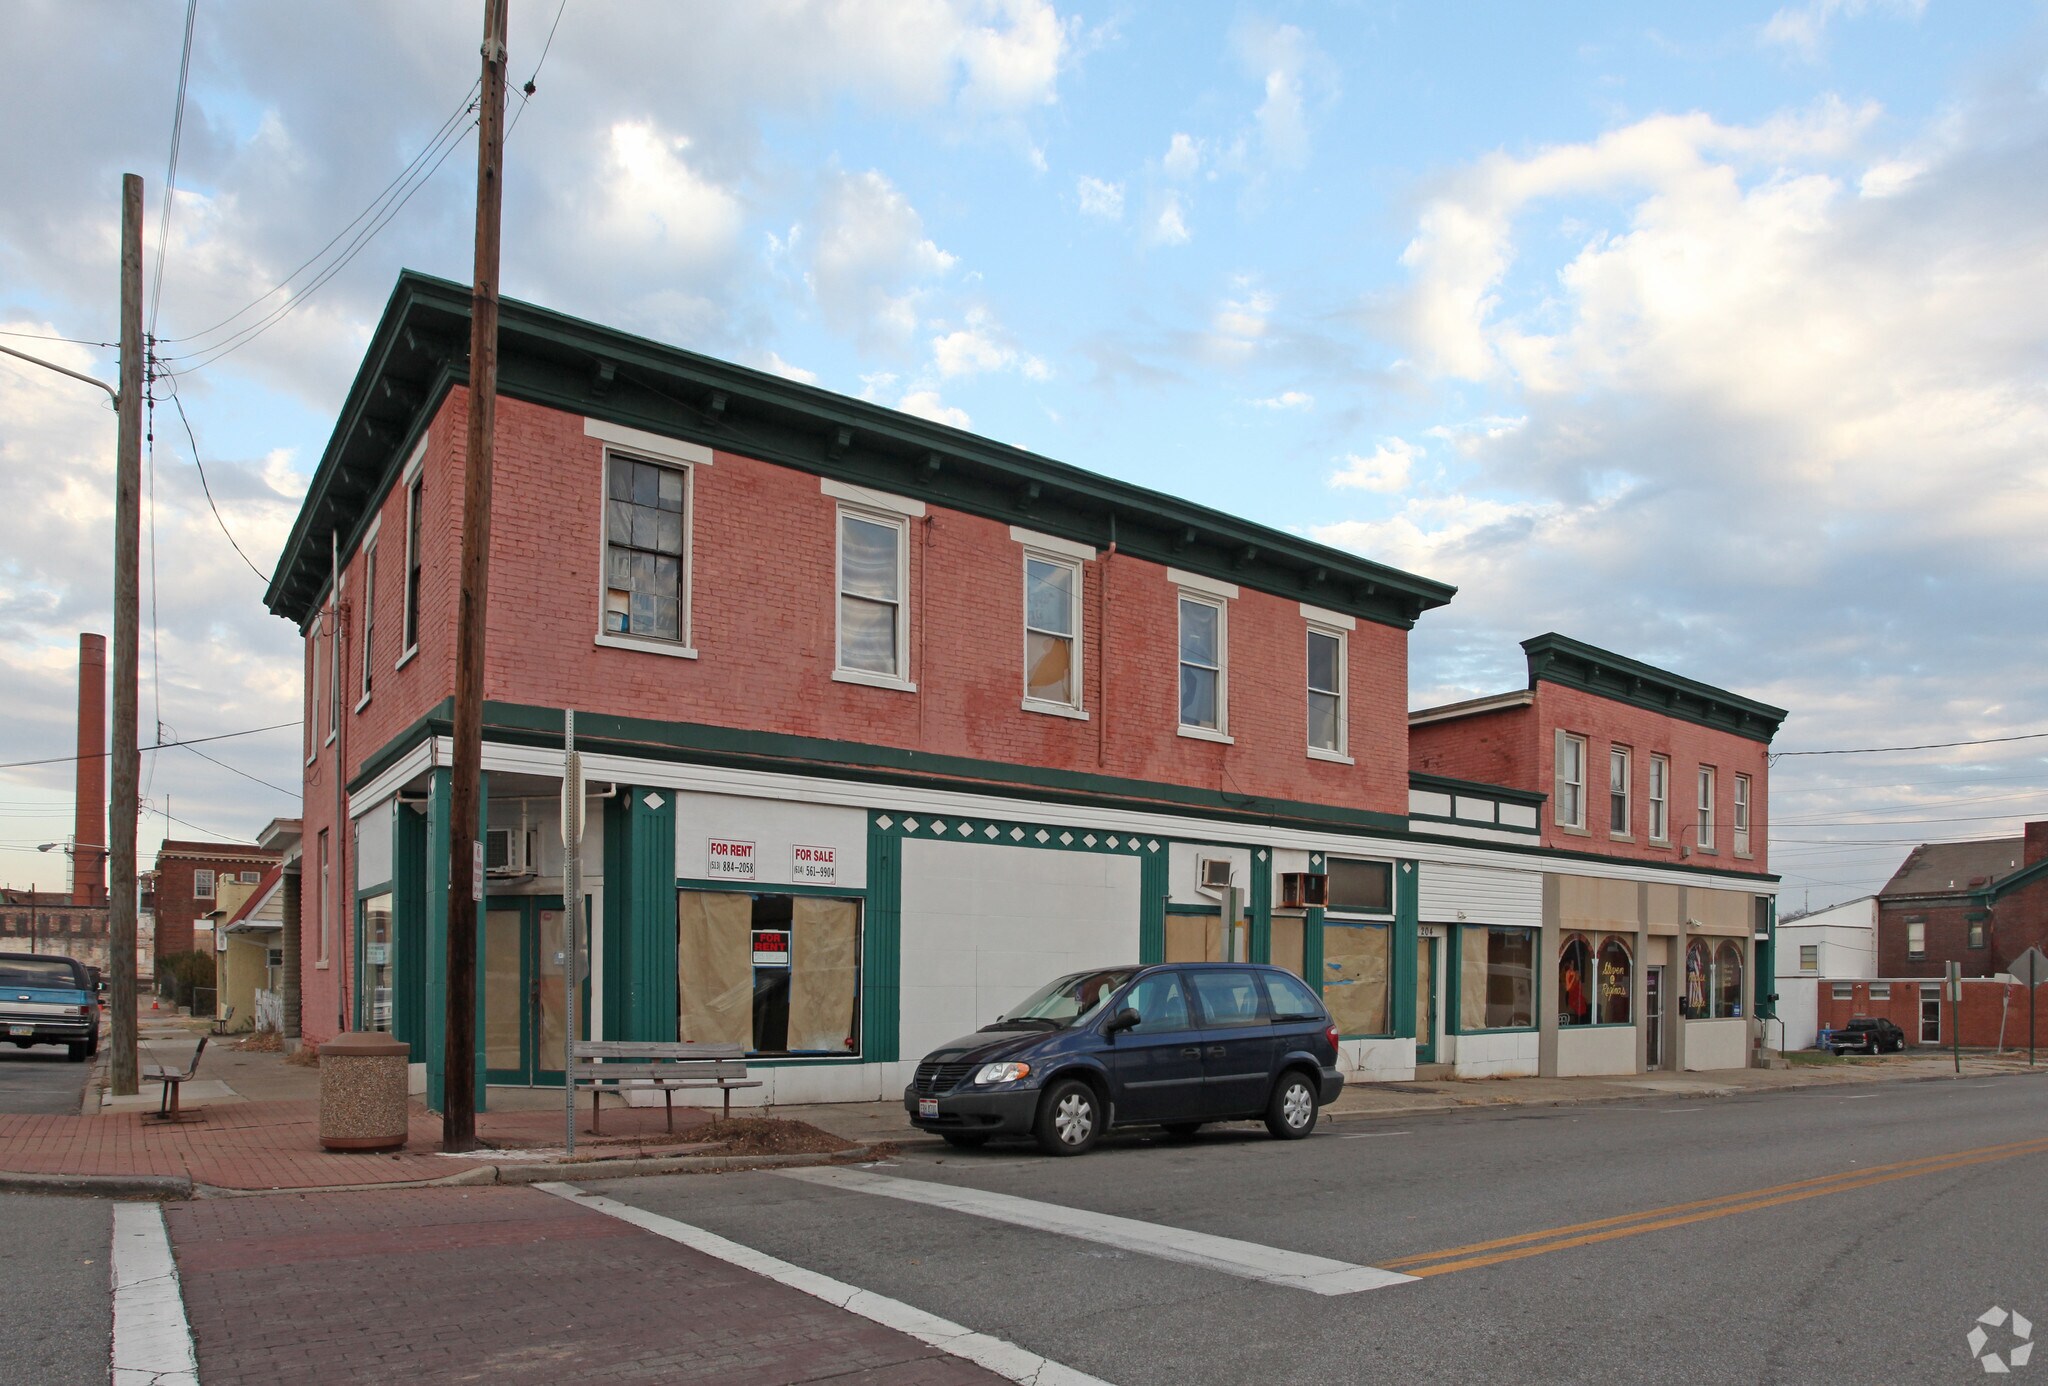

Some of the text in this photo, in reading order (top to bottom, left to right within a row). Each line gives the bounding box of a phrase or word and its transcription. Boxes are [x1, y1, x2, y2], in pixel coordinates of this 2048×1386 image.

[711, 843, 752, 857] FOR RENT
[796, 849, 834, 863] FOR SALE
[723, 861, 754, 873] 884-2058
[806, 866, 834, 877] 561-9904
[1421, 926, 1433, 936] 204
[760, 933, 781, 942] FOR
[754, 942, 786, 951] RENT
